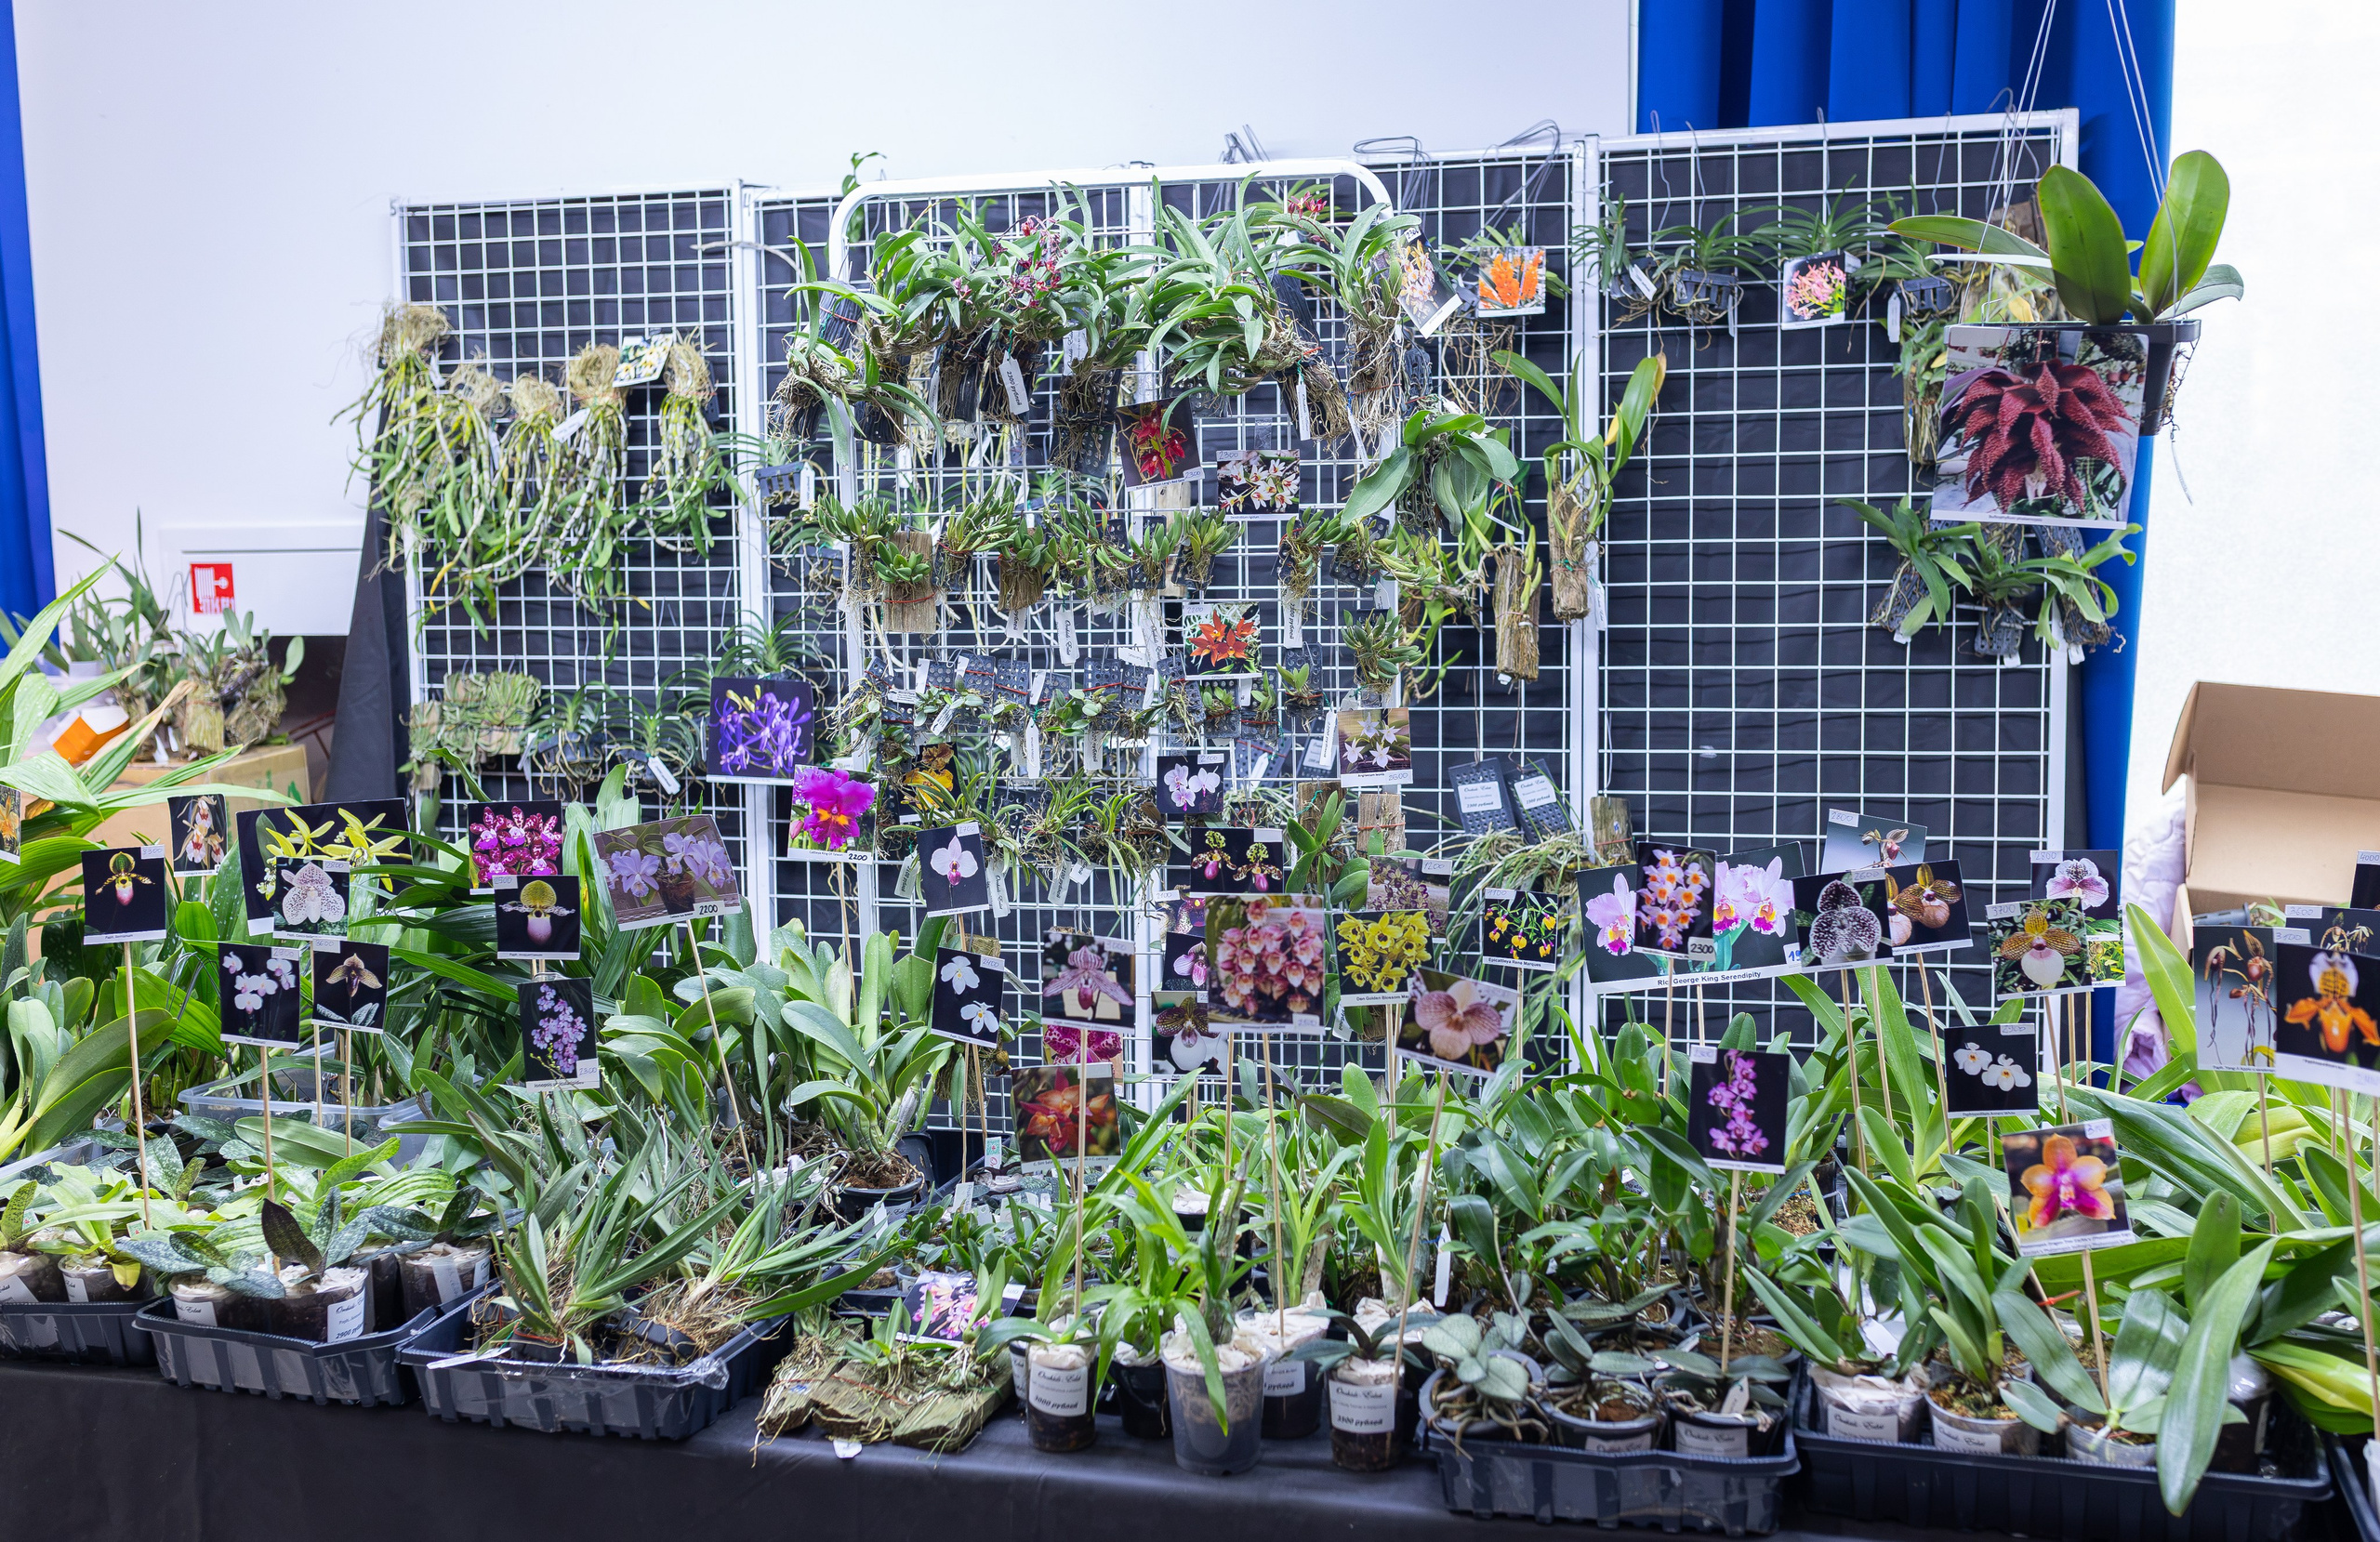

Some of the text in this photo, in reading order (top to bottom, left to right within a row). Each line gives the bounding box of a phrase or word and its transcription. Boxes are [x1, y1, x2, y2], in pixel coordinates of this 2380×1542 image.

[1011, 384, 1023, 407] рублей
[848, 853, 868, 862] 2200
[2034, 851, 2057, 861] 2800
[2360, 853, 2380, 862] 4000
[1422, 862, 1446, 870] 1200
[1853, 872, 1880, 880] 2600
[1055, 876, 1064, 900] рублей
[699, 904, 718, 915] 2200
[1992, 904, 2016, 916] 3700
[1690, 942, 1713, 954] 2300
[1673, 975, 1699, 985] George
[1701, 974, 1719, 984] King
[1720, 970, 1762, 982] Serendipity
[578, 1066, 598, 1076] 2300
[335, 1327, 352, 1340] 2900
[1266, 1381, 1295, 1393] рублей
[1052, 1400, 1079, 1411] рублей
[1355, 1417, 1383, 1429] рублей
